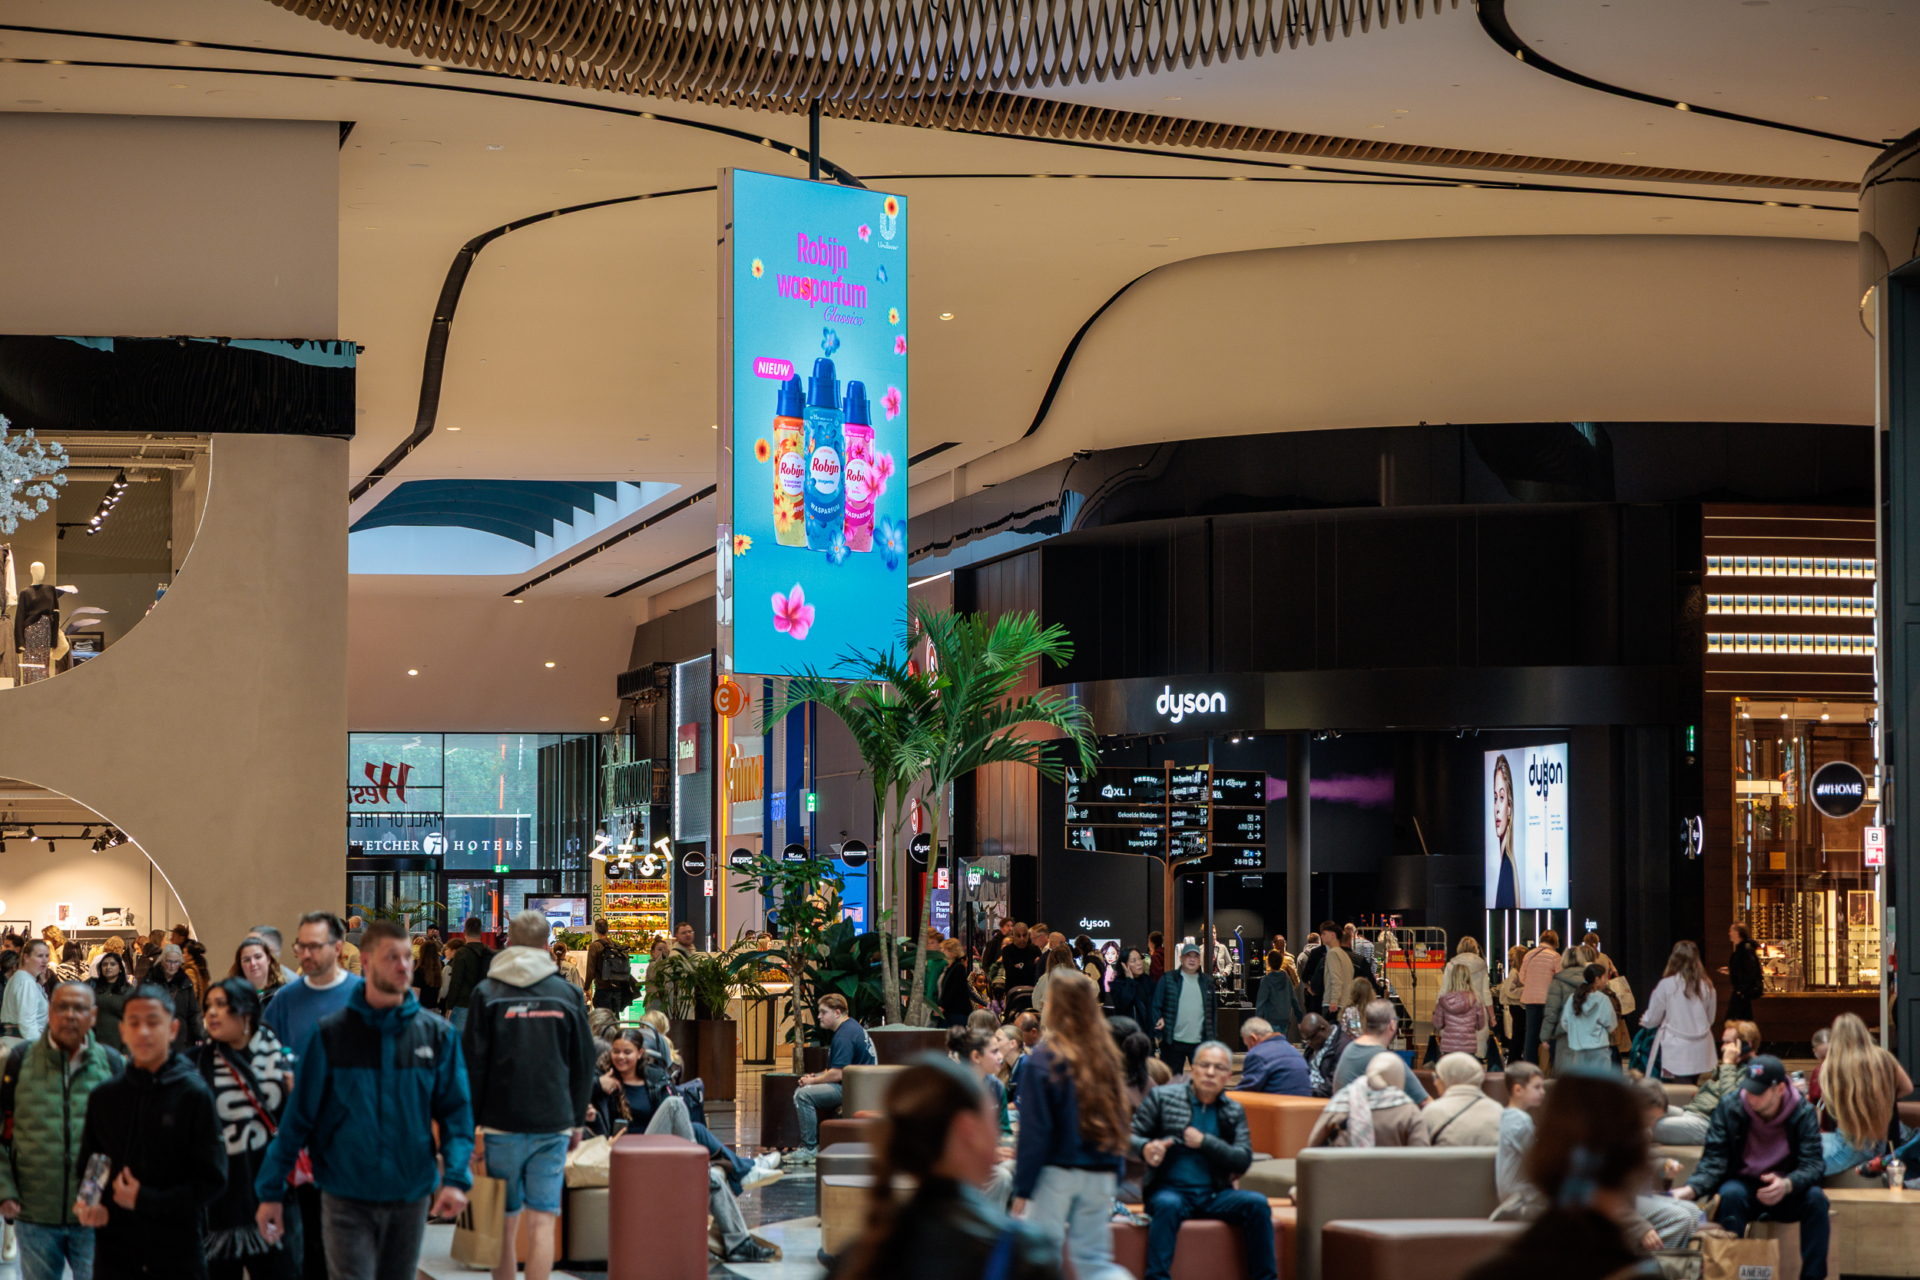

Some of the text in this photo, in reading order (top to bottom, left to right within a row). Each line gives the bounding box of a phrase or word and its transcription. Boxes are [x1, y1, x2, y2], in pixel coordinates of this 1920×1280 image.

[797, 232, 848, 275] Robijn
[777, 273, 867, 308] wasparfum
[824, 305, 865, 326] Classics
[758, 361, 790, 376] NIEUW
[780, 462, 805, 478] Robijn
[812, 457, 839, 476] Robijn
[810, 502, 840, 514] WASPARFUM
[845, 507, 871, 519] WASPARFUM
[1156, 685, 1226, 723] dyson
[679, 739, 694, 759] Miele
[1114, 788, 1126, 796] XL
[351, 841, 522, 851] FLETCHER HOTELS
[593, 884, 603, 922] ORDER
[1079, 917, 1110, 930] dyson
